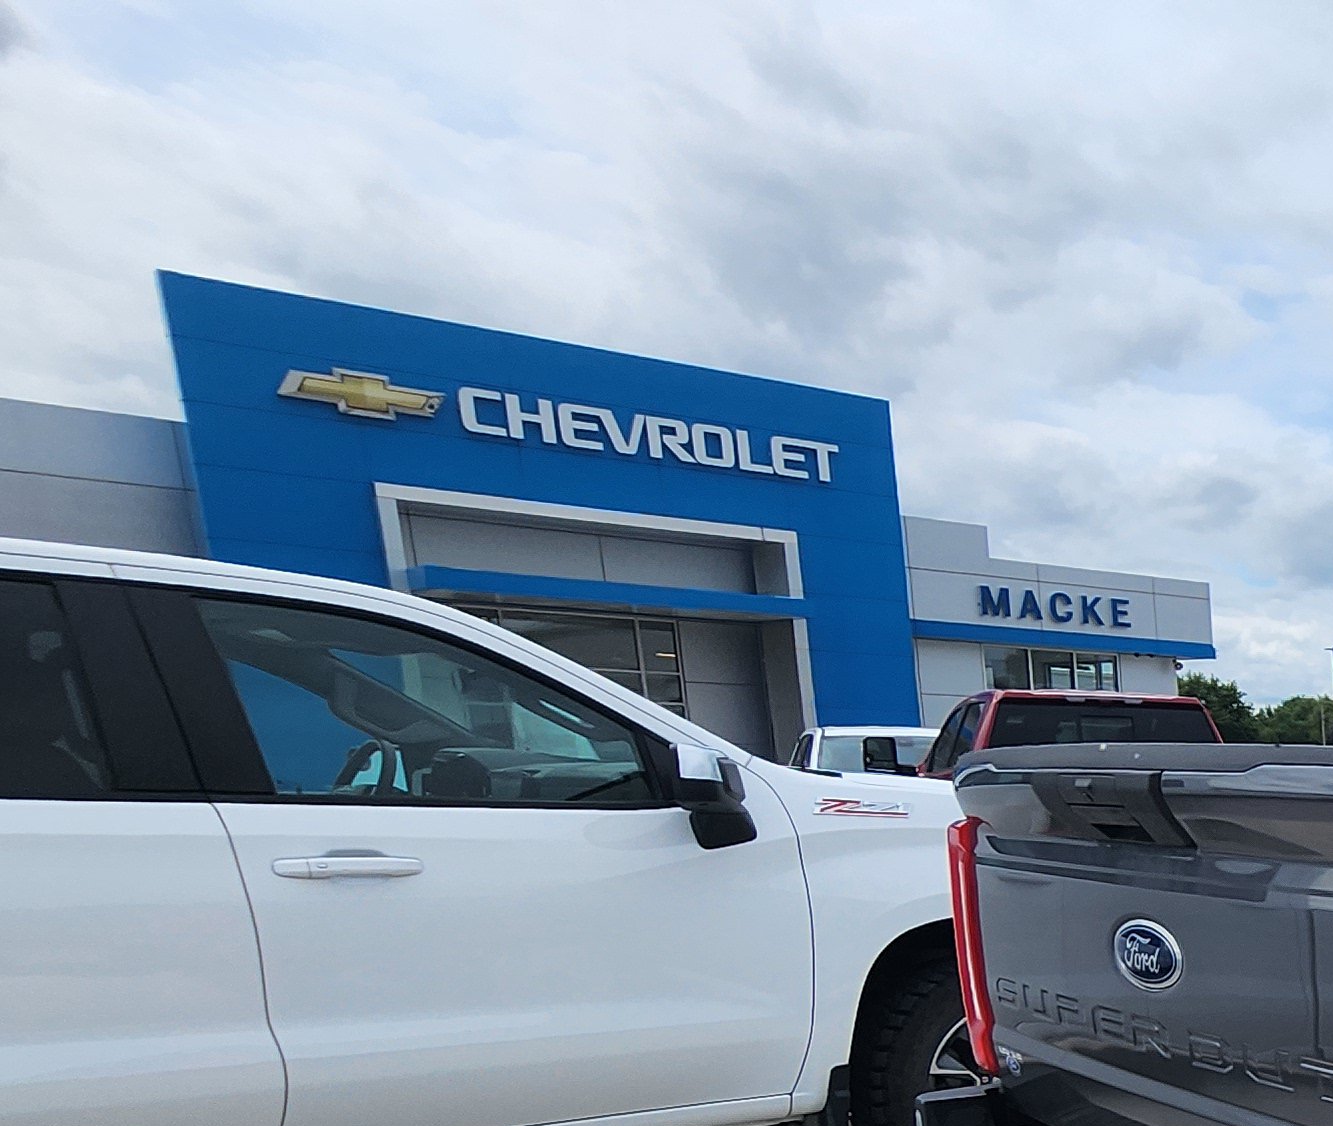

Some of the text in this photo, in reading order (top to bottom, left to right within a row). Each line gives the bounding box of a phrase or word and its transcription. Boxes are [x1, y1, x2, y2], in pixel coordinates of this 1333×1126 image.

[457, 386, 840, 483] CHEVROLET
[978, 584, 1132, 628] MACKE
[1124, 932, 1161, 974] Ford
[995, 976, 1172, 1059] SUPER
